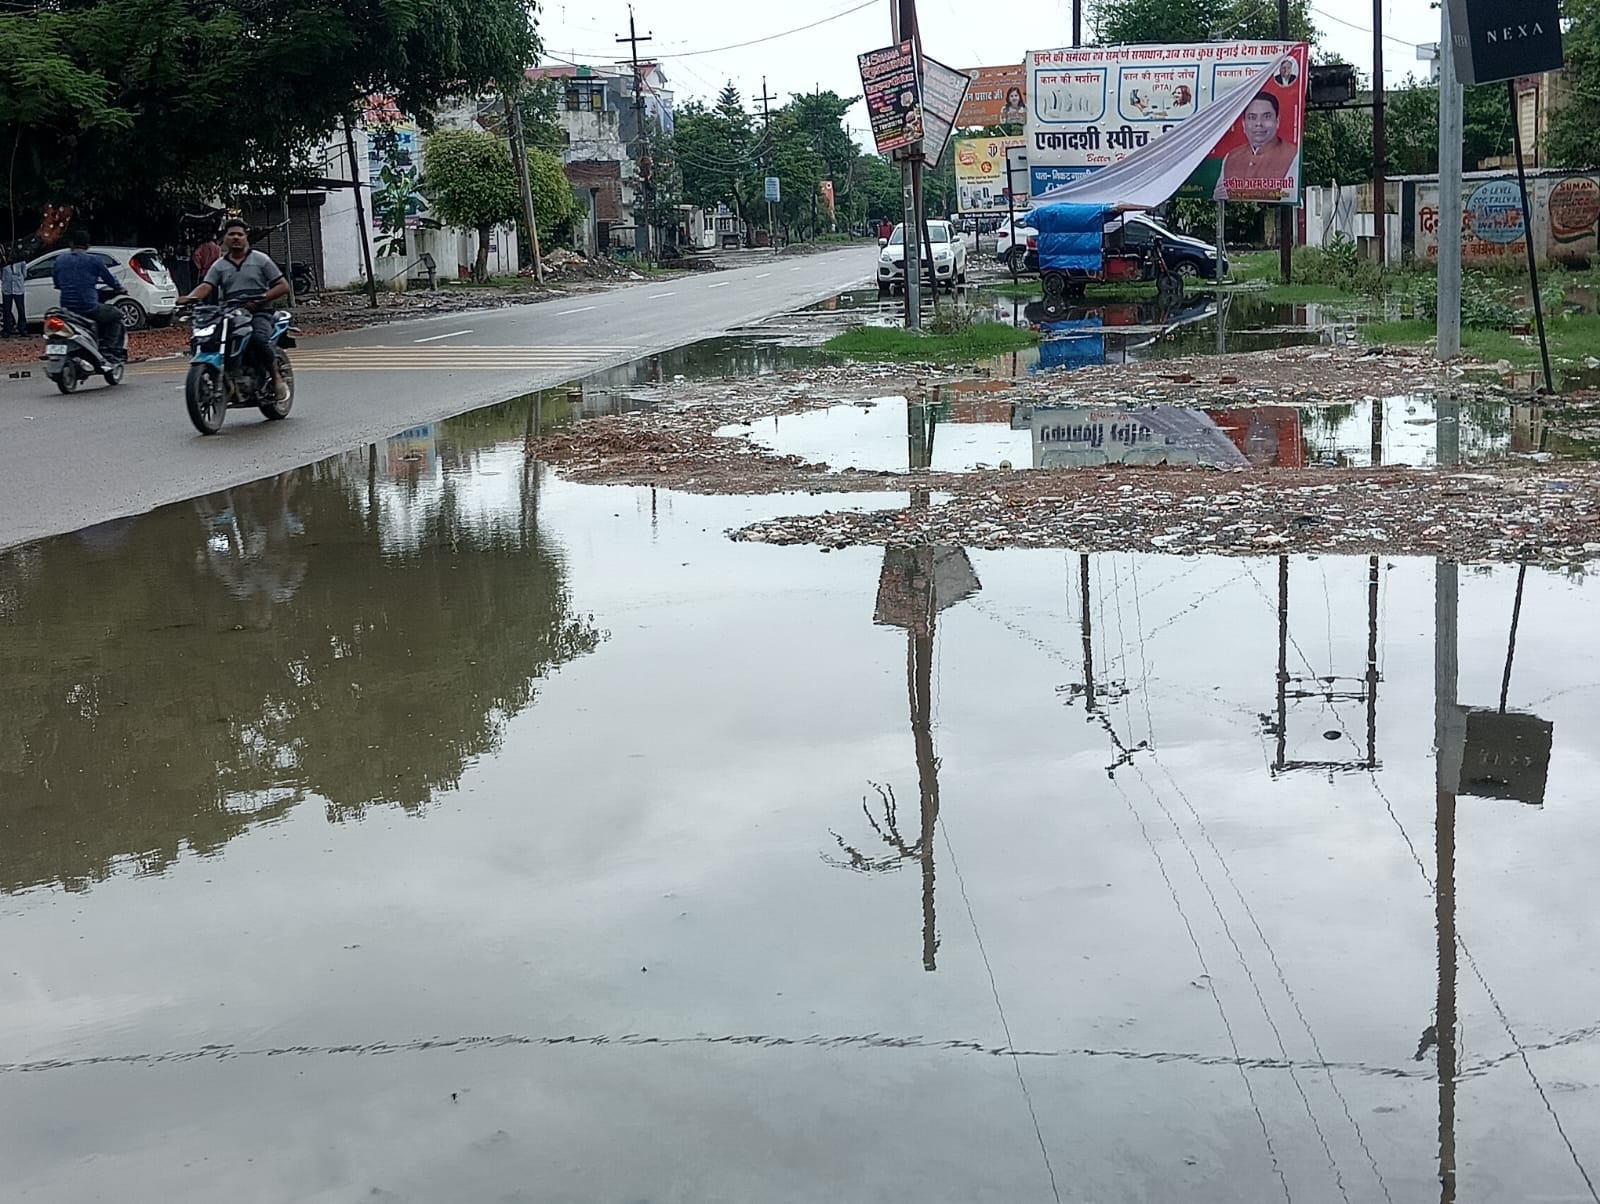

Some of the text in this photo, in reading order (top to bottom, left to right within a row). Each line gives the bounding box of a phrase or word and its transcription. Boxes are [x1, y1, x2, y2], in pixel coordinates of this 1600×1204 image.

[1486, 22, 1543, 44] NEXA
[1053, 51, 1063, 63] की
[1040, 72, 1100, 85] कान की मशीन
[1141, 70, 1151, 80] की
[1152, 83, 1172, 92] (PTA)
[1035, 126, 1101, 150] एकादशी
[1106, 126, 1149, 149] स्पीच
[1560, 182, 1593, 191] SUMAN
